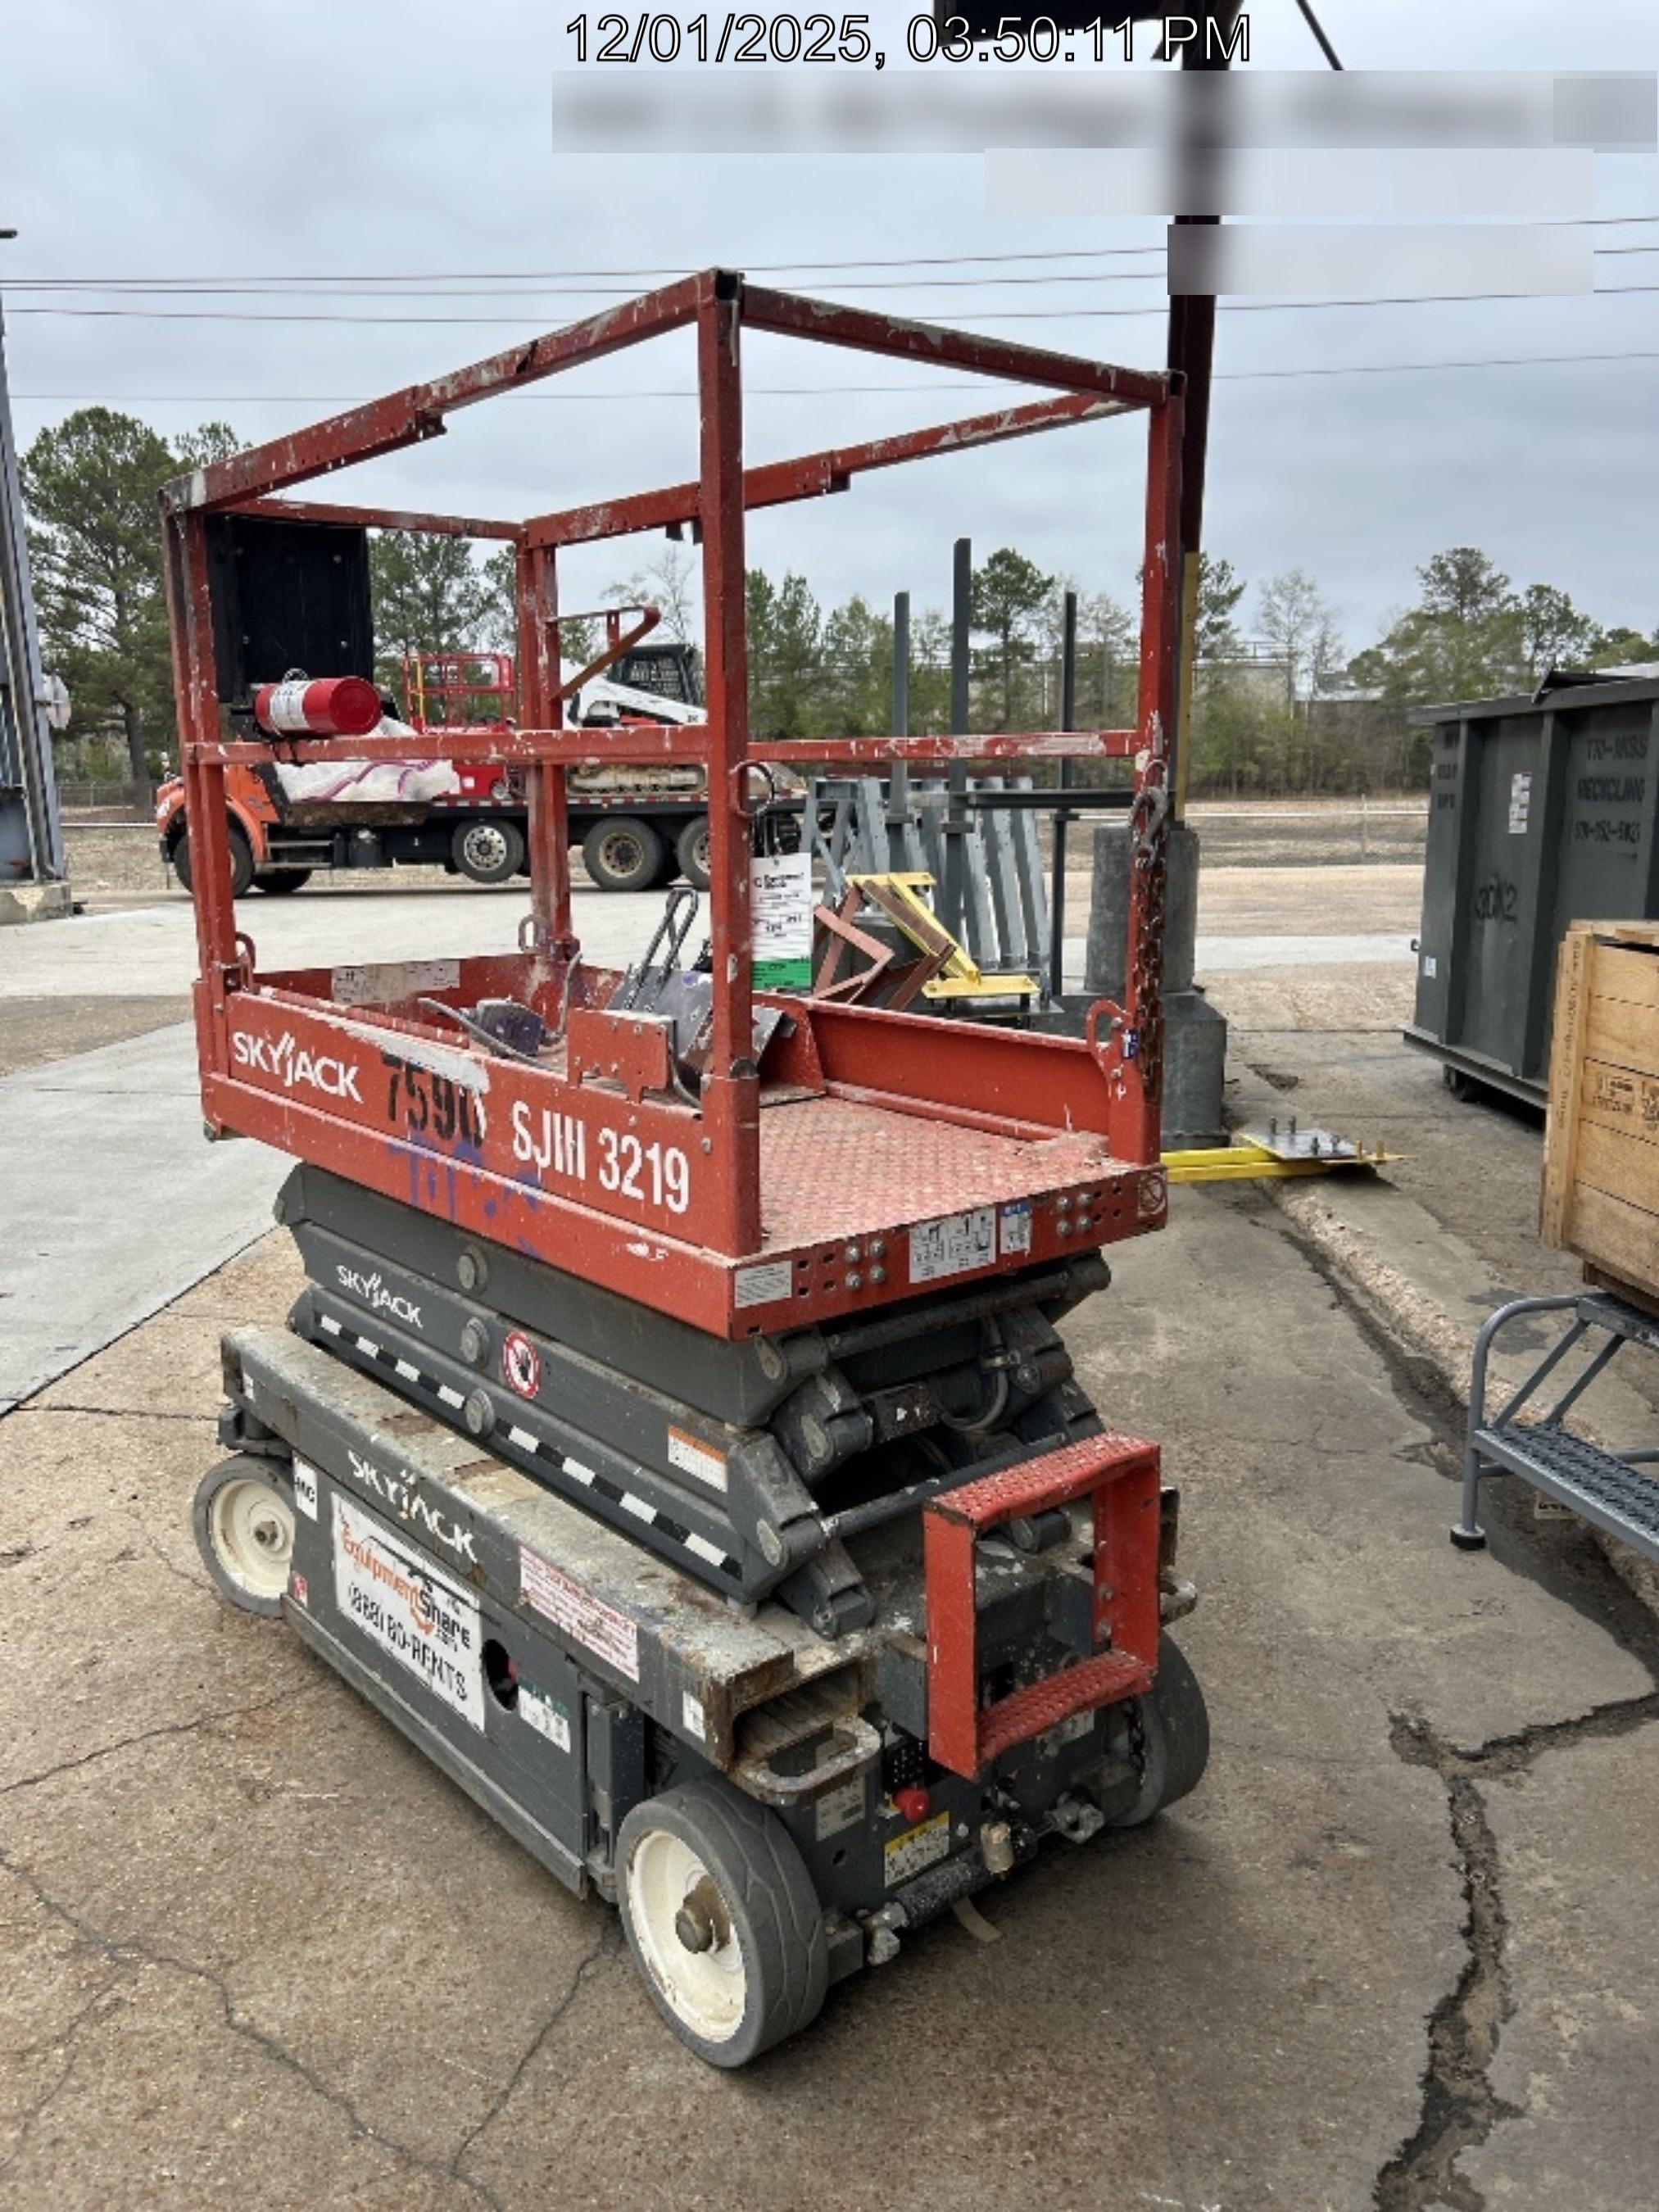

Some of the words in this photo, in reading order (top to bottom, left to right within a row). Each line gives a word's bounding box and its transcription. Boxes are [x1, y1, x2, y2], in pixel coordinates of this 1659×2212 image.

[231, 1030, 364, 1104] SKYJACK
[512, 1100, 587, 1180] SJIII
[598, 1127, 689, 1214] 3219
[336, 1265, 424, 1329] SKYJACK
[347, 1448, 478, 1564] SKYJACK
